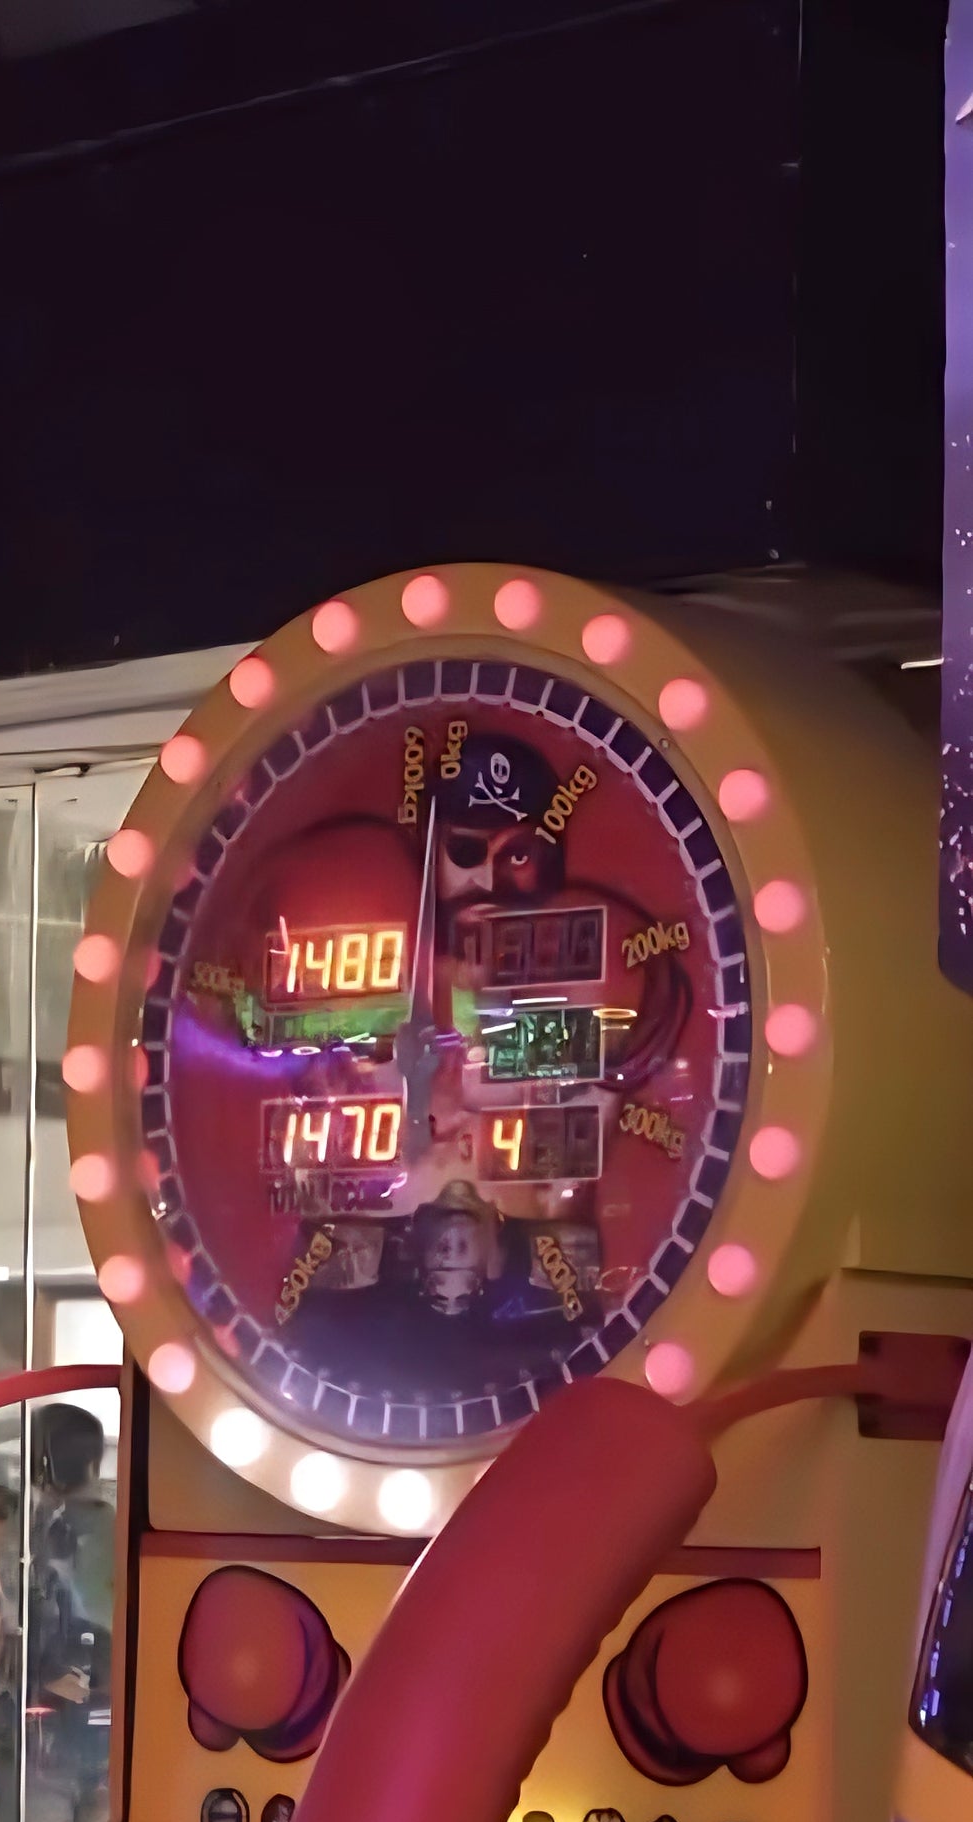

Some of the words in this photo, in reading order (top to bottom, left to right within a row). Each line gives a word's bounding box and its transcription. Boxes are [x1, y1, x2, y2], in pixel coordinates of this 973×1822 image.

[397, 726, 425, 824] 600kg
[440, 720, 468, 779] 0kg
[535, 764, 597, 844] 100kg
[286, 930, 404, 993] 1480
[621, 921, 690, 968] 200kg
[283, 1103, 401, 1165] 1470
[492, 1118, 524, 1171] 4
